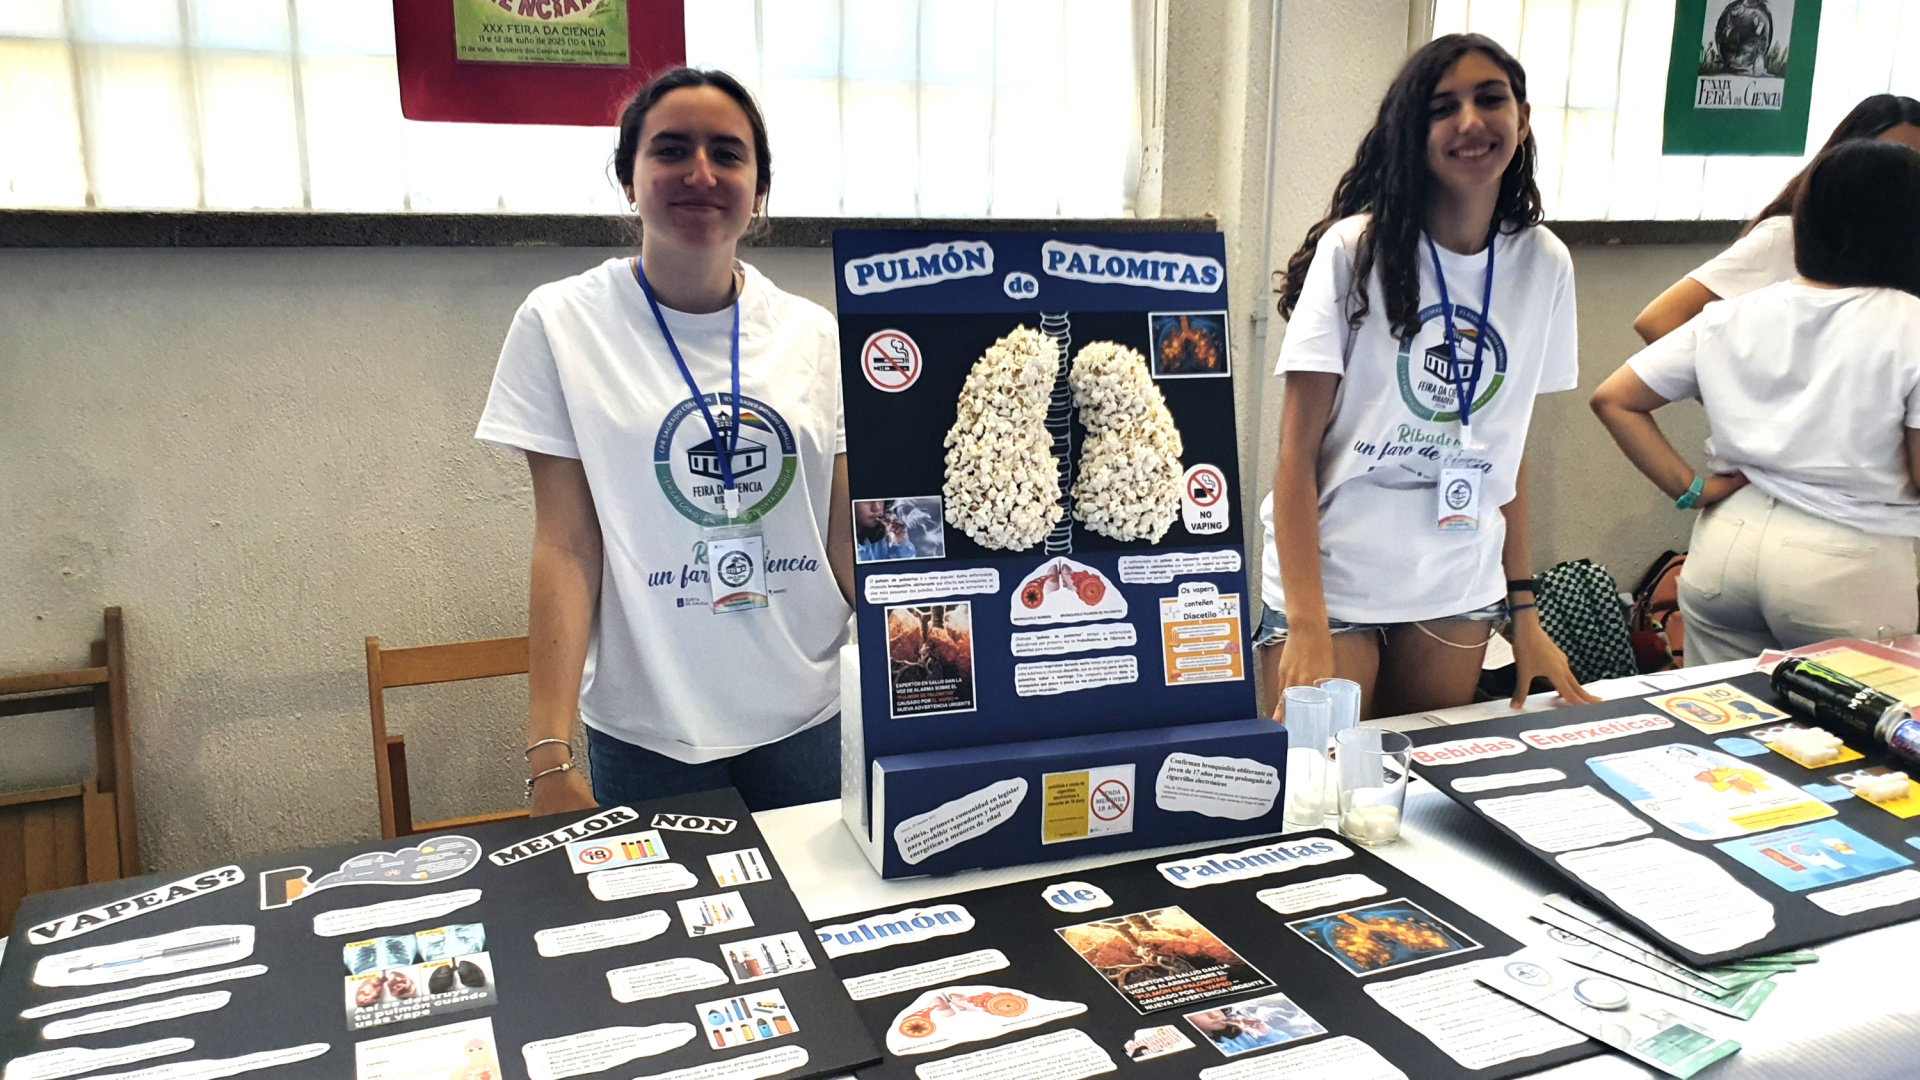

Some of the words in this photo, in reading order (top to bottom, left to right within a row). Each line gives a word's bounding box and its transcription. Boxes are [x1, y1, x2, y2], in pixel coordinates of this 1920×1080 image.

[483, 23, 504, 34] XXX
[507, 24, 540, 35] FEIRA
[543, 25, 559, 36] DA
[562, 27, 606, 38] CIENCIA
[548, 38, 566, 46] 2025
[1744, 81, 1781, 107] CIENCIA
[854, 245, 987, 287] PULMÓN
[1047, 249, 1218, 287] PALOMITAS
[1008, 276, 1035, 295] de
[1417, 381, 1436, 393] FEIRA
[1438, 385, 1447, 395] DA
[1353, 439, 1376, 456] un
[1378, 441, 1415, 461] faro
[1418, 445, 1441, 461] de
[693, 484, 715, 498] FEIRA
[1200, 511, 1212, 519] NO
[1191, 522, 1223, 531] VAPING
[648, 573, 676, 588] un
[680, 564, 710, 589] far
[764, 555, 819, 574] iencia
[1192, 586, 1215, 594] vapers
[1184, 599, 1214, 608] conteñen
[1183, 612, 1217, 620] Diacetilo
[1703, 689, 1731, 699] NO
[1413, 737, 1515, 765] Bebidas
[1526, 713, 1671, 748] Enerxéticas
[1167, 765, 1184, 774] joven
[1214, 772, 1224, 780] por
[1235, 775, 1265, 785] prolongado
[1170, 757, 1201, 768] Confirman
[1237, 767, 1266, 777] obliterante
[1166, 774, 1194, 783] cigarrillos
[1195, 777, 1228, 787] electrónicos
[654, 814, 735, 833] NON
[904, 830, 929, 844] Galicia,
[929, 817, 955, 834] primera
[956, 800, 989, 820] comunidad
[997, 786, 1020, 800] legislar
[907, 843, 922, 853] para
[923, 829, 949, 845] prohibir
[949, 813, 984, 832] vapeadores
[989, 798, 1013, 813] bebidas
[500, 811, 634, 865] MELLOR
[909, 840, 944, 859] energéticas
[950, 825, 976, 840] menores
[977, 820, 985, 828] de
[986, 812, 1002, 823] edad
[1164, 840, 1335, 882] Palomitas
[29, 869, 240, 940] VAPEAS?
[1050, 888, 1097, 907] de
[1124, 977, 1165, 991] EXPERTOS
[1175, 969, 1202, 980] SALUD
[1201, 966, 1219, 974] DAN
[1218, 963, 1231, 971] LA
[1129, 988, 1146, 996] VOZ
[1157, 979, 1191, 990] ALARMA
[1191, 973, 1217, 982] SOBRE
[354, 1003, 380, 1015] Así
[383, 1001, 401, 1010] se
[402, 988, 470, 1006] destruye
[1139, 993, 1179, 1005] CAUSADO
[1178, 989, 1196, 998] POR
[1206, 981, 1233, 992] VAPEO
[1144, 1001, 1173, 1011] NUEVA
[1173, 989, 1229, 1005] ADVERTENCIA
[1228, 980, 1266, 993] URGENTE
[354, 1012, 371, 1021] tu
[374, 1002, 431, 1019] pulmón
[433, 991, 488, 1008] cuando
[355, 1018, 391, 1029] usas
[394, 1009, 431, 1021] vape
